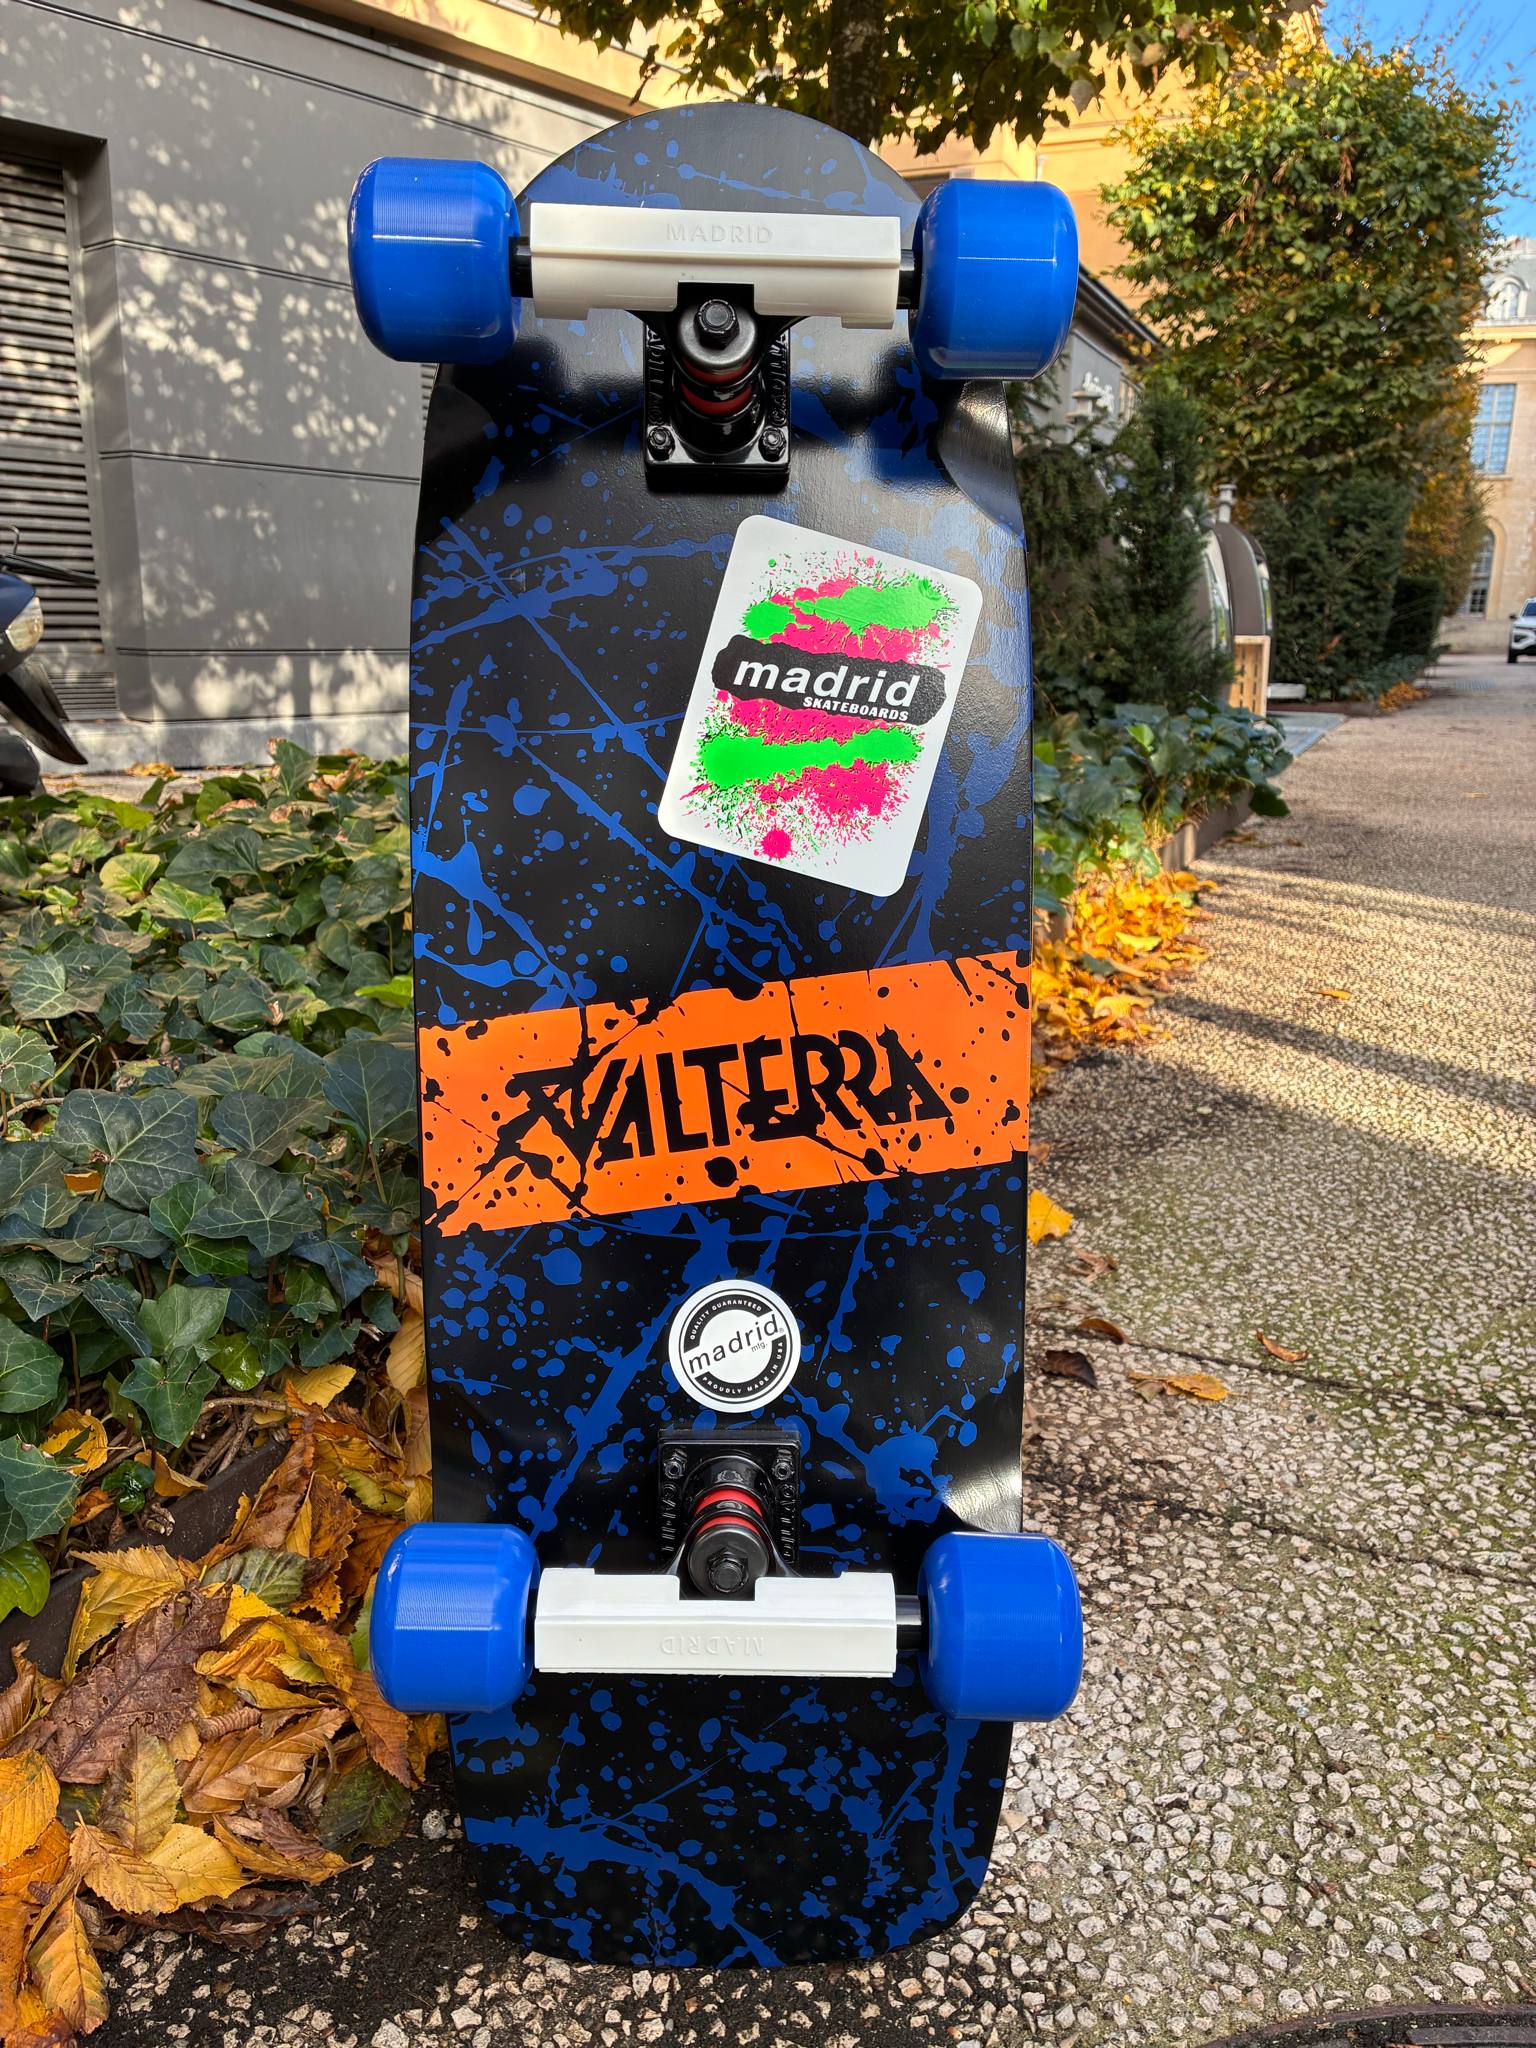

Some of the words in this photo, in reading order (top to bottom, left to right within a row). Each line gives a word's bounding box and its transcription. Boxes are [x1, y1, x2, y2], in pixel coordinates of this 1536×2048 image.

[666, 222, 774, 246] MADRID
[733, 659, 921, 708] madrid
[802, 695, 910, 722] SKATEBOARDS
[508, 1026, 953, 1174] VALTERRA
[689, 1310, 711, 1341] QUALITY
[711, 1299, 762, 1312] GUARANTEED
[688, 1313, 779, 1374] madrid
[702, 1376, 742, 1395] PROUDLY
[746, 1376, 770, 1393] MADE
[770, 1364, 779, 1375] IN
[776, 1342, 784, 1361] USA
[659, 1635, 765, 1657] MADRID
